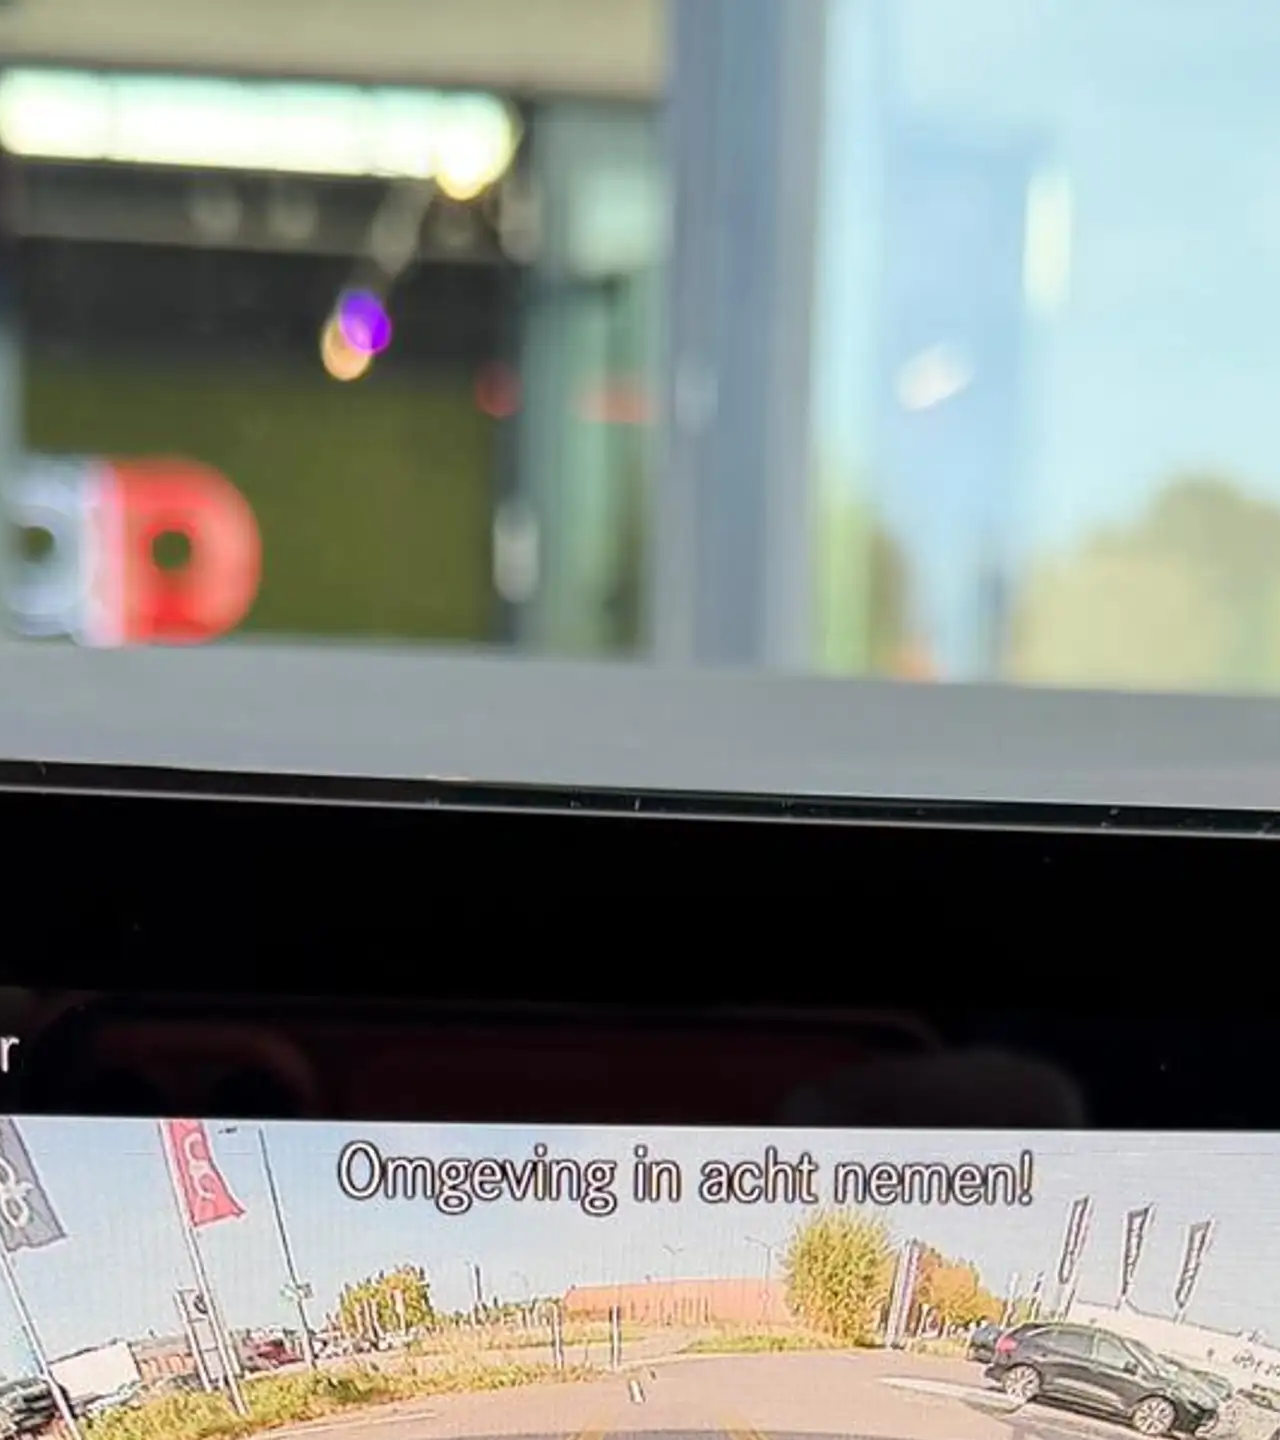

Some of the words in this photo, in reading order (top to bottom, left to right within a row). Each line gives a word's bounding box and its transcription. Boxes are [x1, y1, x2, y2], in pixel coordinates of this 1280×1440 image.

[338, 1140, 615, 1216] Omgeving
[633, 1147, 681, 1203] in
[698, 1147, 819, 1205] acht
[833, 1151, 1034, 1206] nemen!
